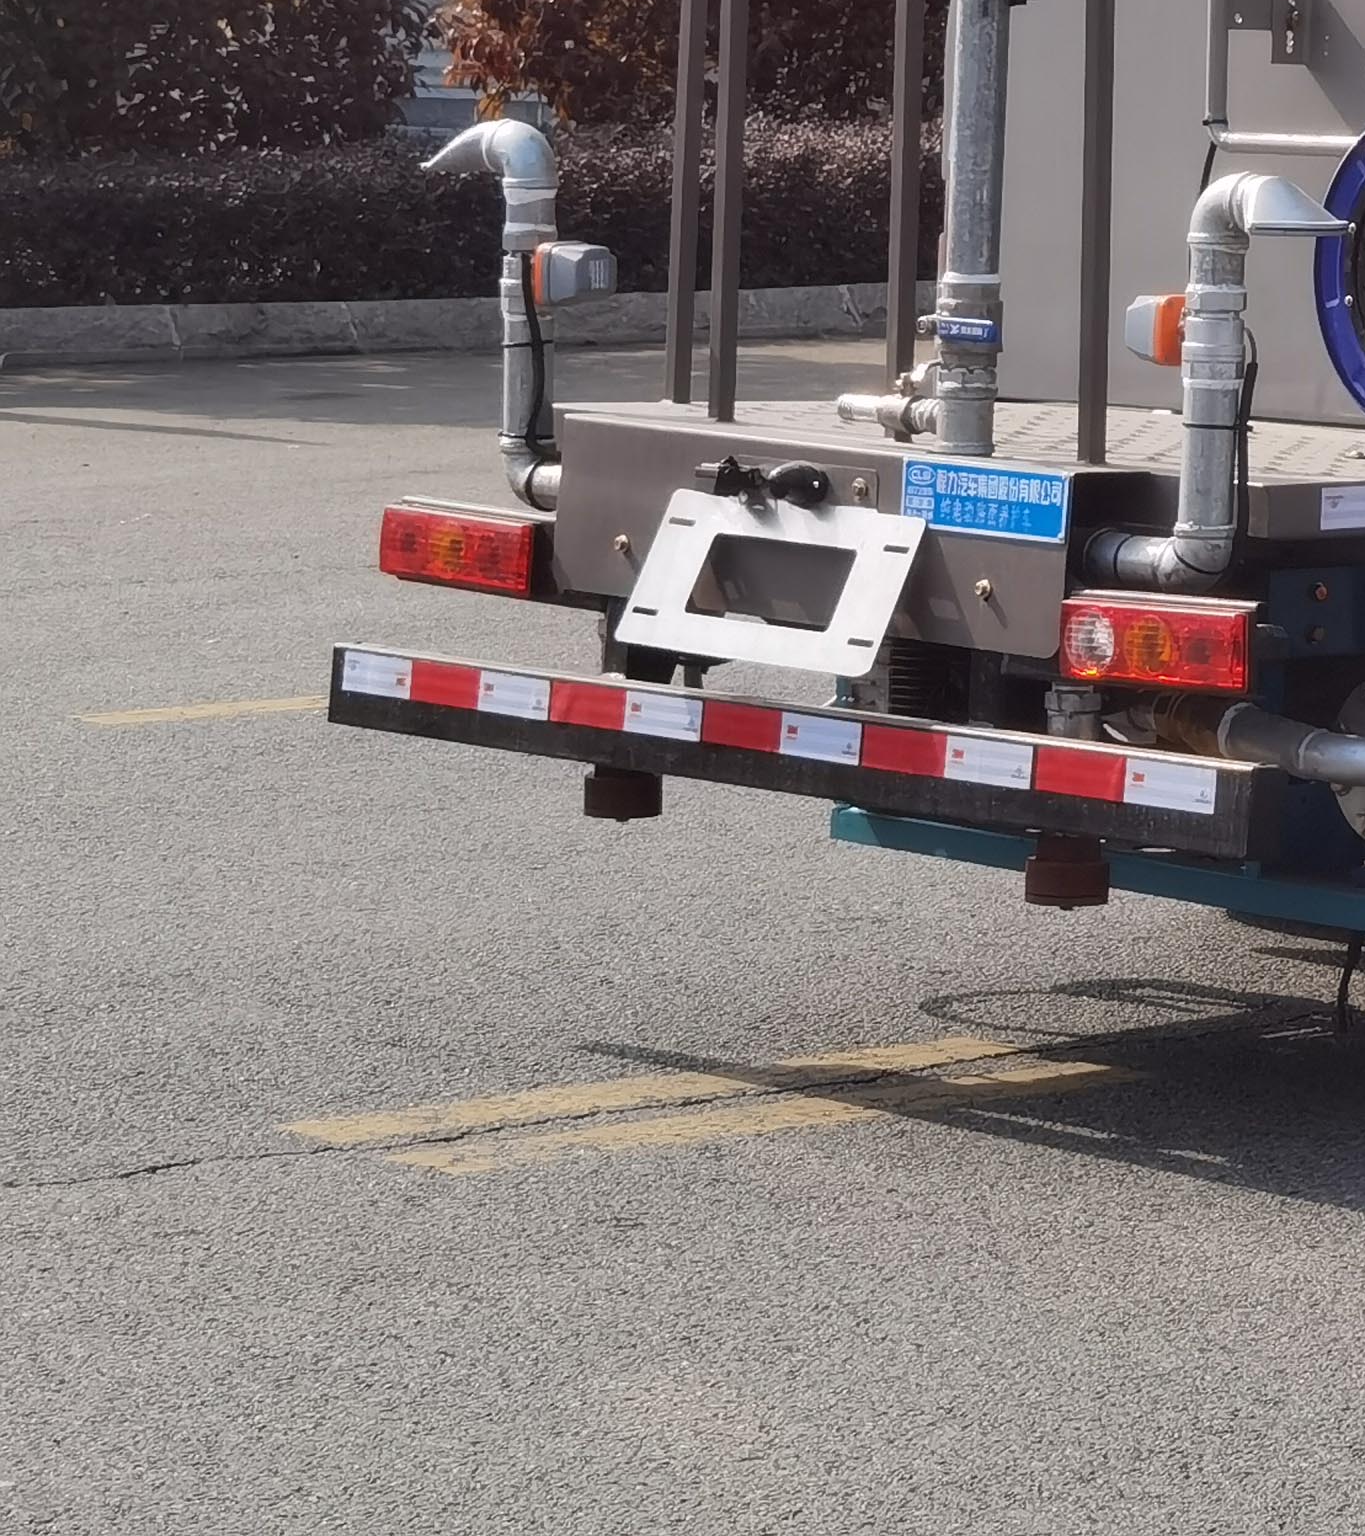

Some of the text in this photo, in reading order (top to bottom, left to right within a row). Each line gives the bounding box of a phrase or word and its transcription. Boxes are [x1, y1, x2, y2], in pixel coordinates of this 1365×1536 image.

[935, 469, 1062, 506] 程力汽车集团股份有限公司
